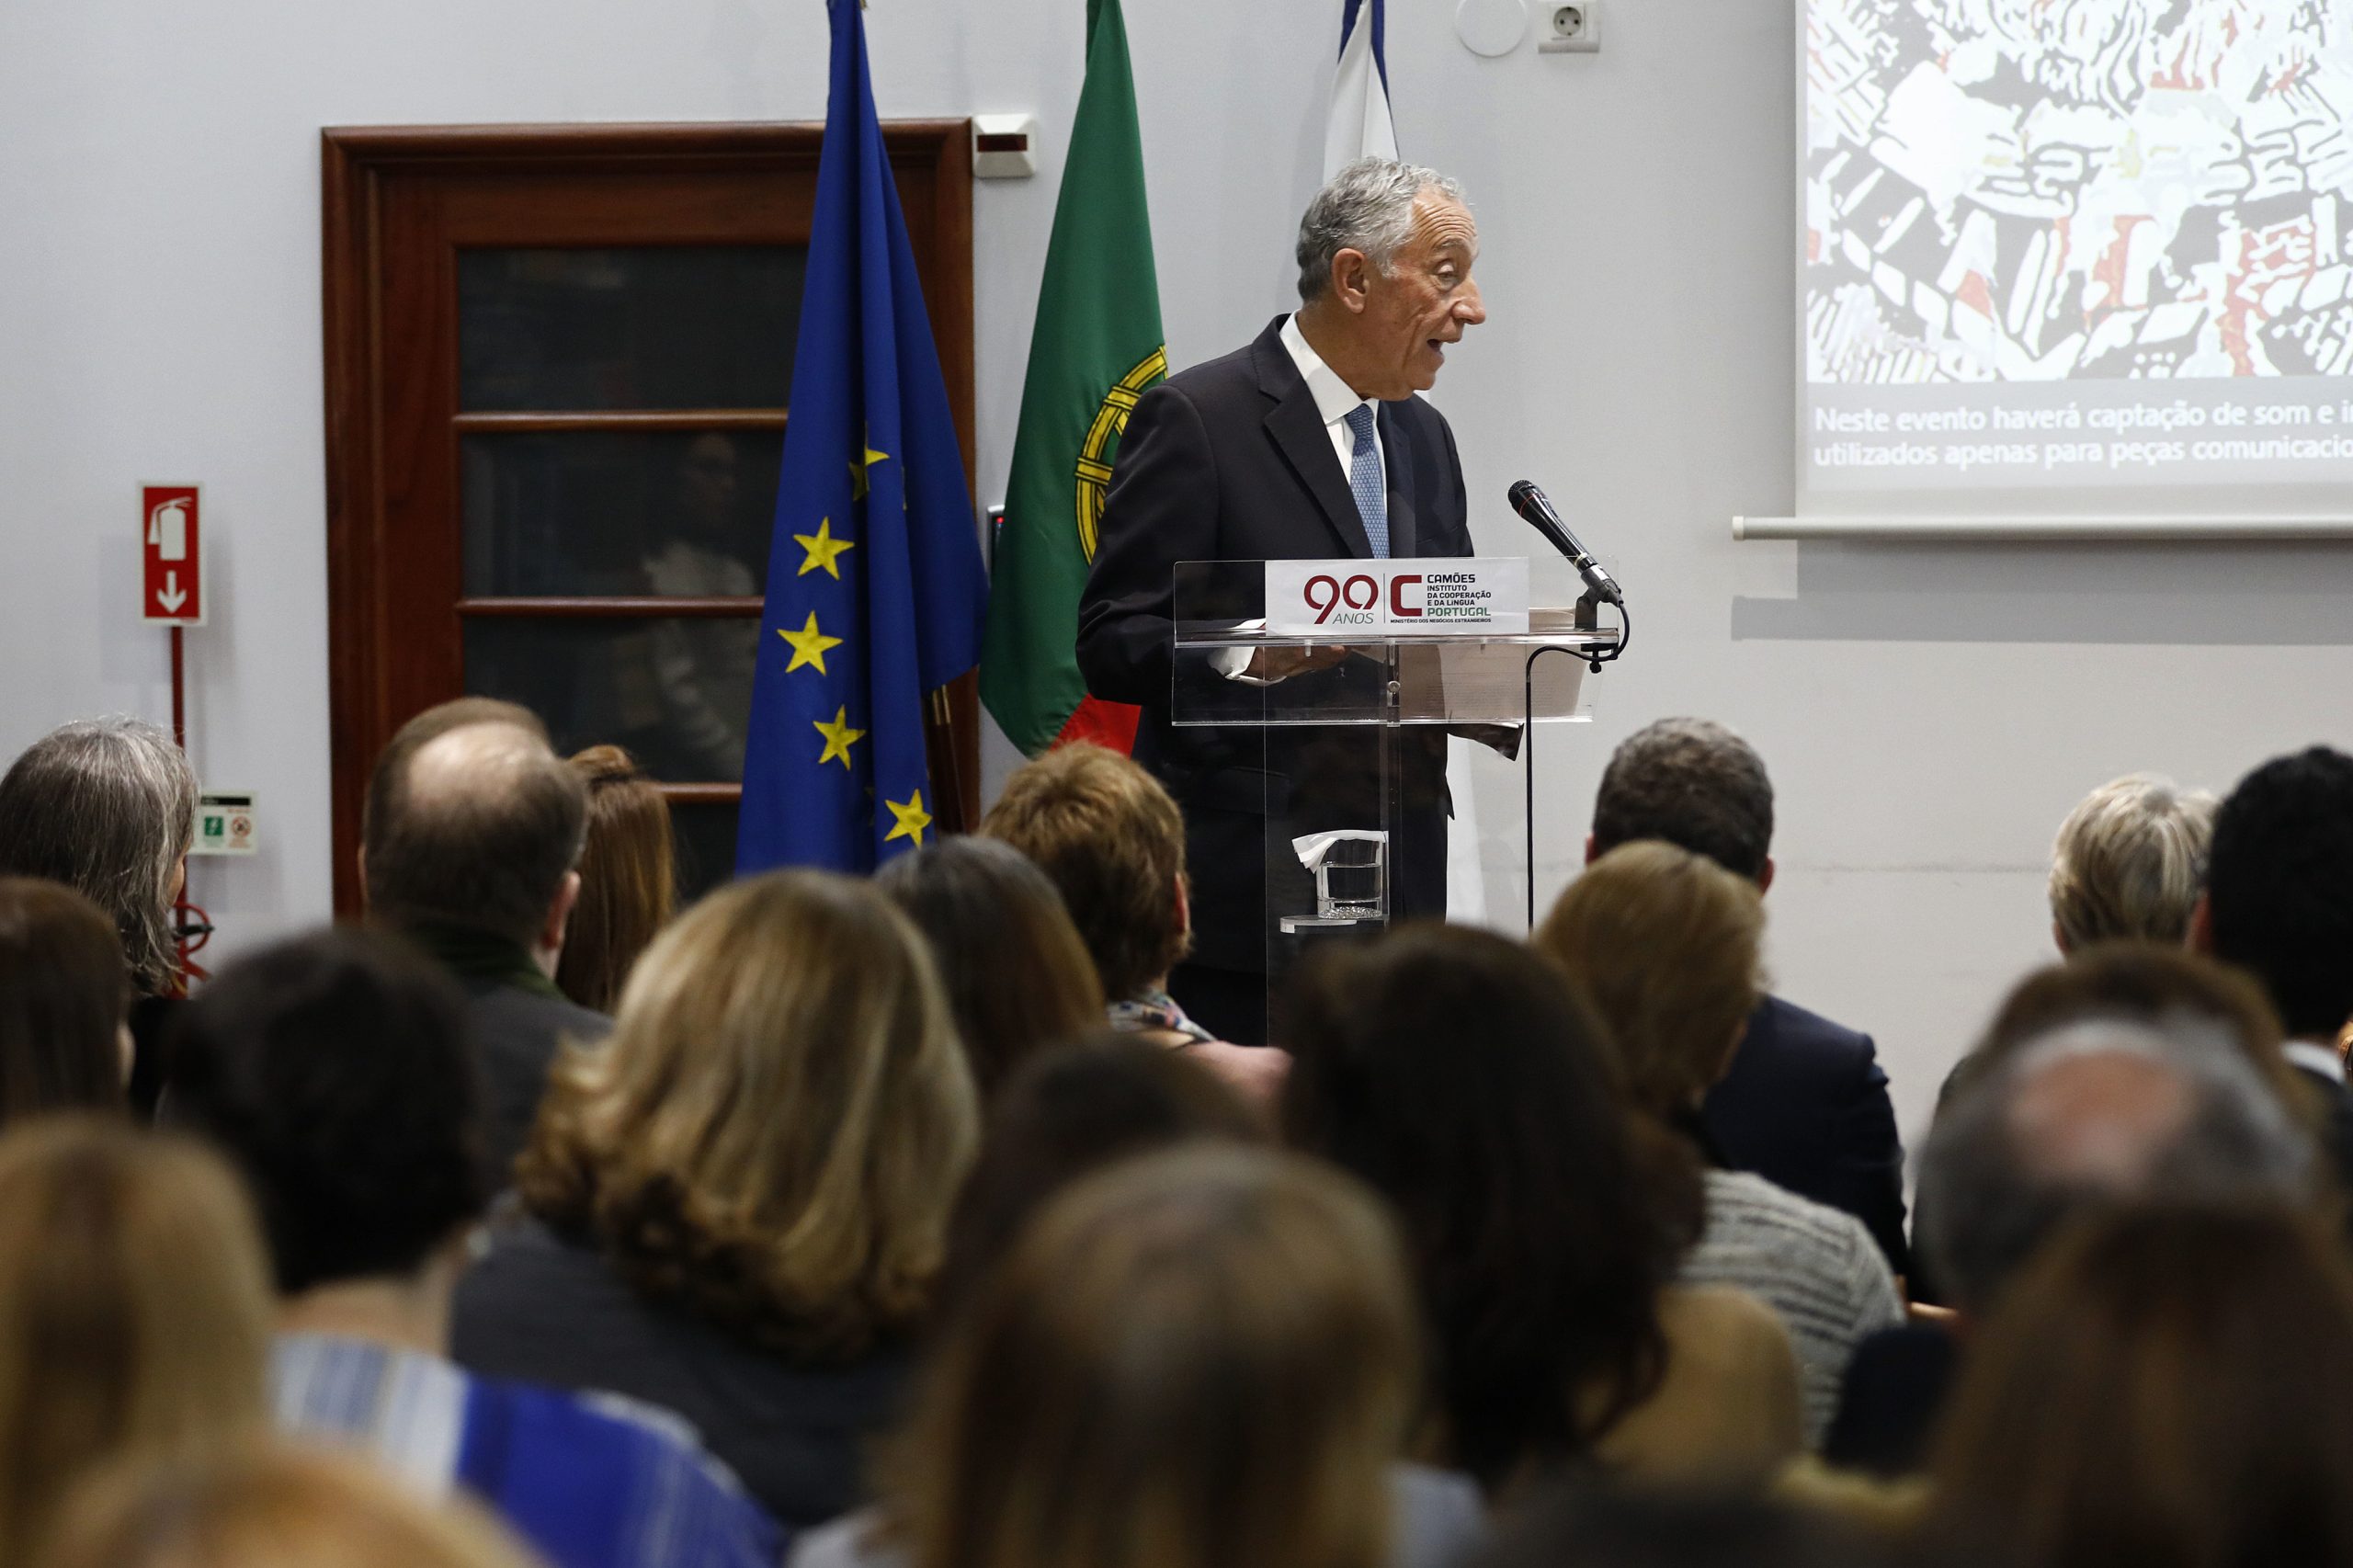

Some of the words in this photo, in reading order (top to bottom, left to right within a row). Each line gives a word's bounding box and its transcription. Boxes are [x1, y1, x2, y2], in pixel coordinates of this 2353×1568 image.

[1815, 407, 1891, 432] Neste
[1895, 406, 1986, 432] evento
[1993, 402, 2081, 429] haverá
[2086, 400, 2206, 435] captação
[2212, 402, 2247, 426] de
[2254, 404, 2311, 425] som
[2316, 404, 2335, 424] e
[1814, 442, 1939, 466] utilizados
[1944, 443, 2038, 472] apenas
[2044, 440, 2104, 470] para
[2110, 441, 2186, 470] peças
[1427, 573, 1475, 583] CAMÕES
[1439, 590, 1492, 600] COOPERAÇÃO
[1333, 612, 1374, 624] ANOS
[1427, 608, 1492, 617] PORTUGAL
